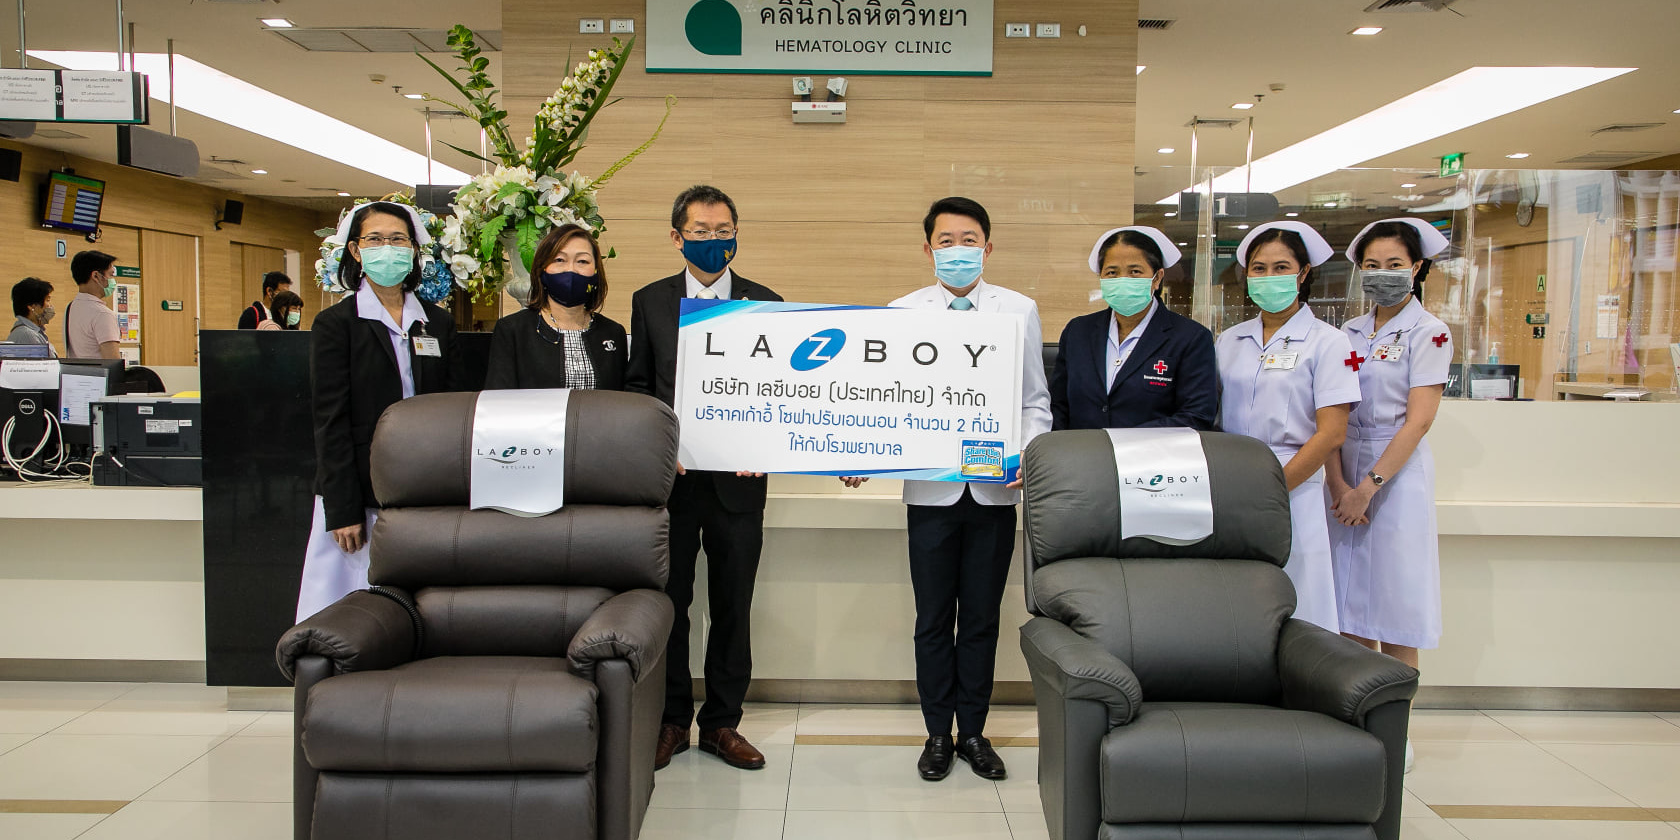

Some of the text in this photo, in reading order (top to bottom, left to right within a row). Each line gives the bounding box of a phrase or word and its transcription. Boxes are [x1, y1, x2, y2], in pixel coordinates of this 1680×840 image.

[760, 0, 967, 26] คลินิกโลหิตวิทยา
[775, 39, 952, 54] HEMATOLOGY CLINIC
[58, 241, 66, 257] D
[1537, 275, 1545, 291] A
[701, 377, 986, 408] บริษัท เลซีบอย (ประเทศไทย) จำกัด
[695, 401, 1000, 434] บริจาคเก้าอี้ โซฟาปรับเอนนอน จำนวน 2 ที่นั่ง
[788, 431, 903, 456] ให้กับโรงพยาบาล
[966, 447, 986, 456] Share
[964, 455, 1000, 466] Comfort
